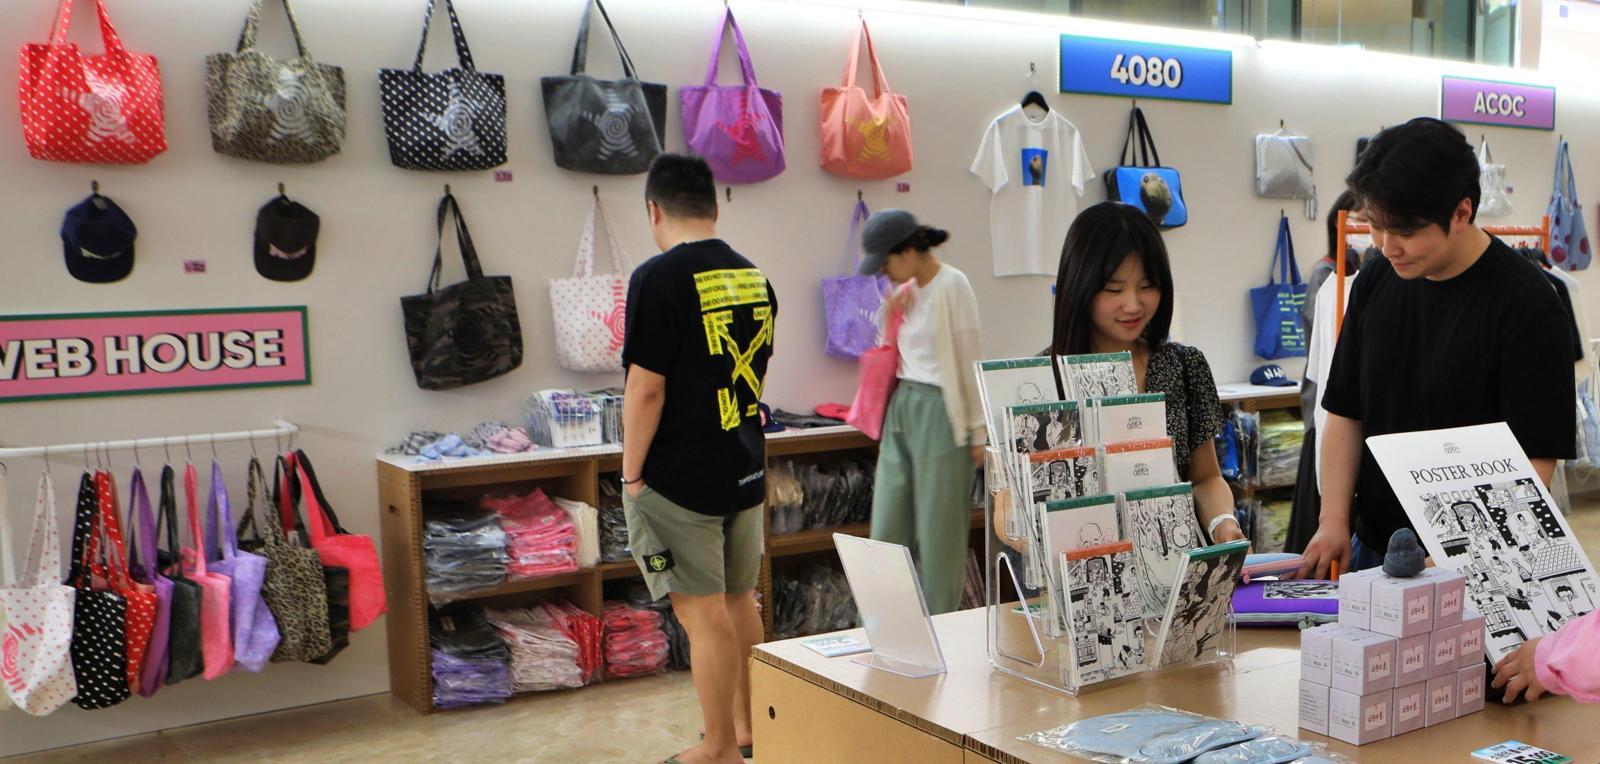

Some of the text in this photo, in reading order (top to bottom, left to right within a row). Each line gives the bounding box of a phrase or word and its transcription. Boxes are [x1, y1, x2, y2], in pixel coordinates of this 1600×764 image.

[1110, 54, 1183, 89] 4080
[1473, 91, 1526, 118] ACOC
[103, 328, 285, 375] HOUSE
[1409, 458, 1518, 485] POSTER BOOK
